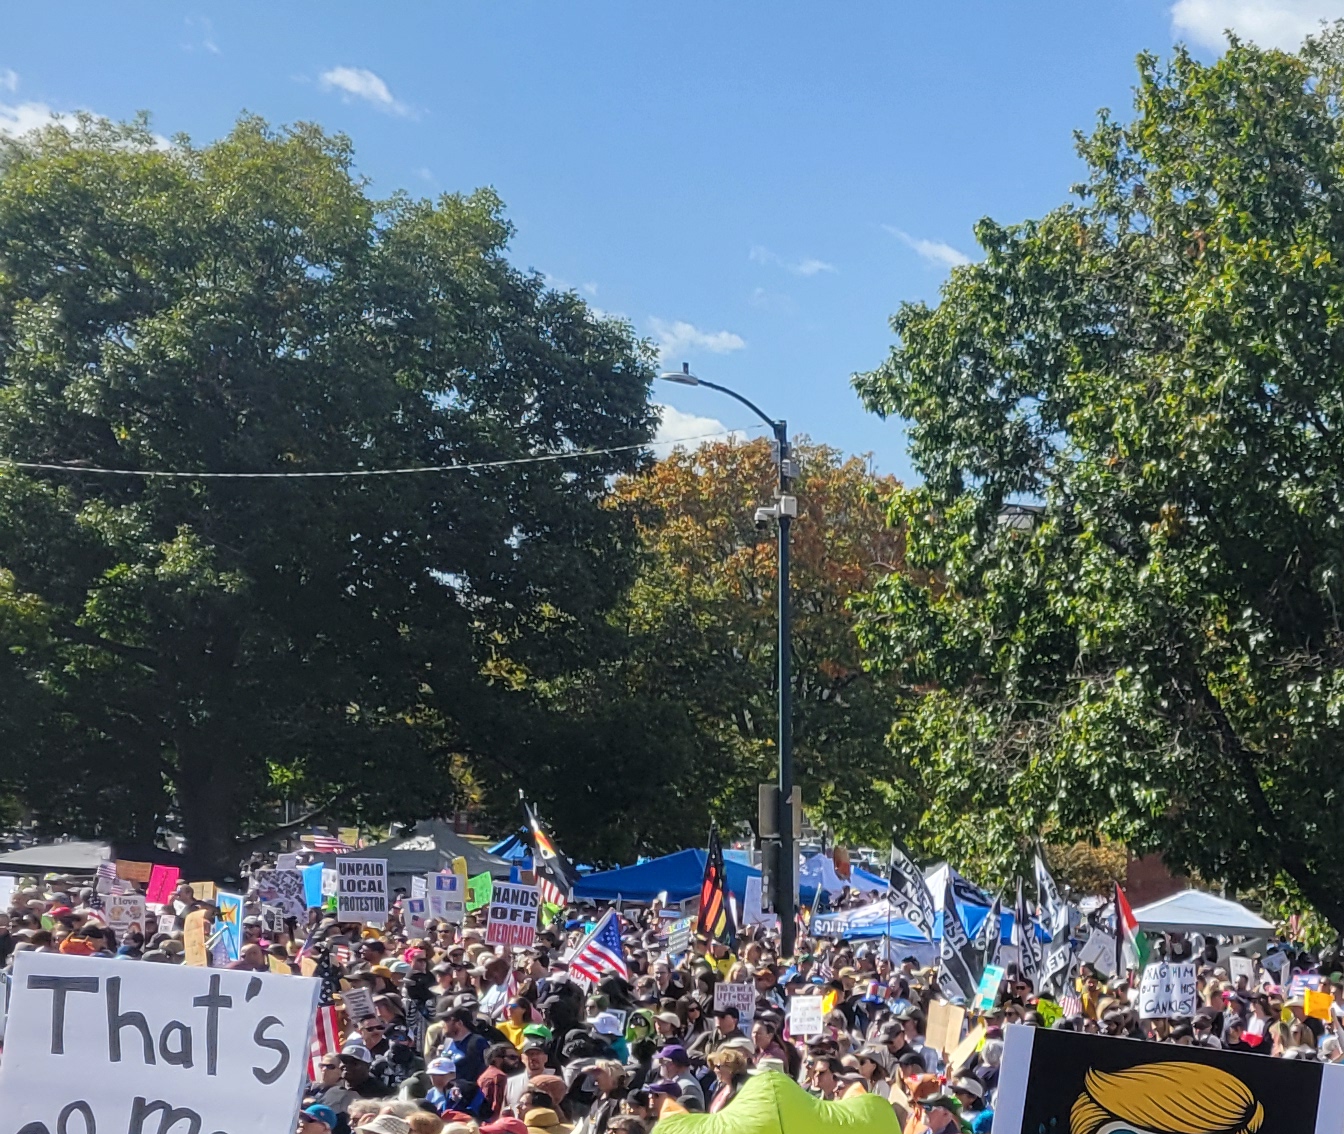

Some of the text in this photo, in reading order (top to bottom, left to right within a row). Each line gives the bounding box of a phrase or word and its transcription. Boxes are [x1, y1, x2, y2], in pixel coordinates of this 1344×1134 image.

[339, 862, 384, 877] UNPAID
[340, 879, 385, 893] LOCAL
[339, 896, 386, 912] PROTESTOR
[491, 885, 539, 908] HANDS
[490, 907, 537, 924] OFF
[887, 887, 931, 935] EACE
[487, 922, 535, 948] MEDICAID
[1172, 966, 1194, 978] HIM
[1142, 983, 1195, 995] OUT BY HIS
[27, 973, 291, 1085] That's
